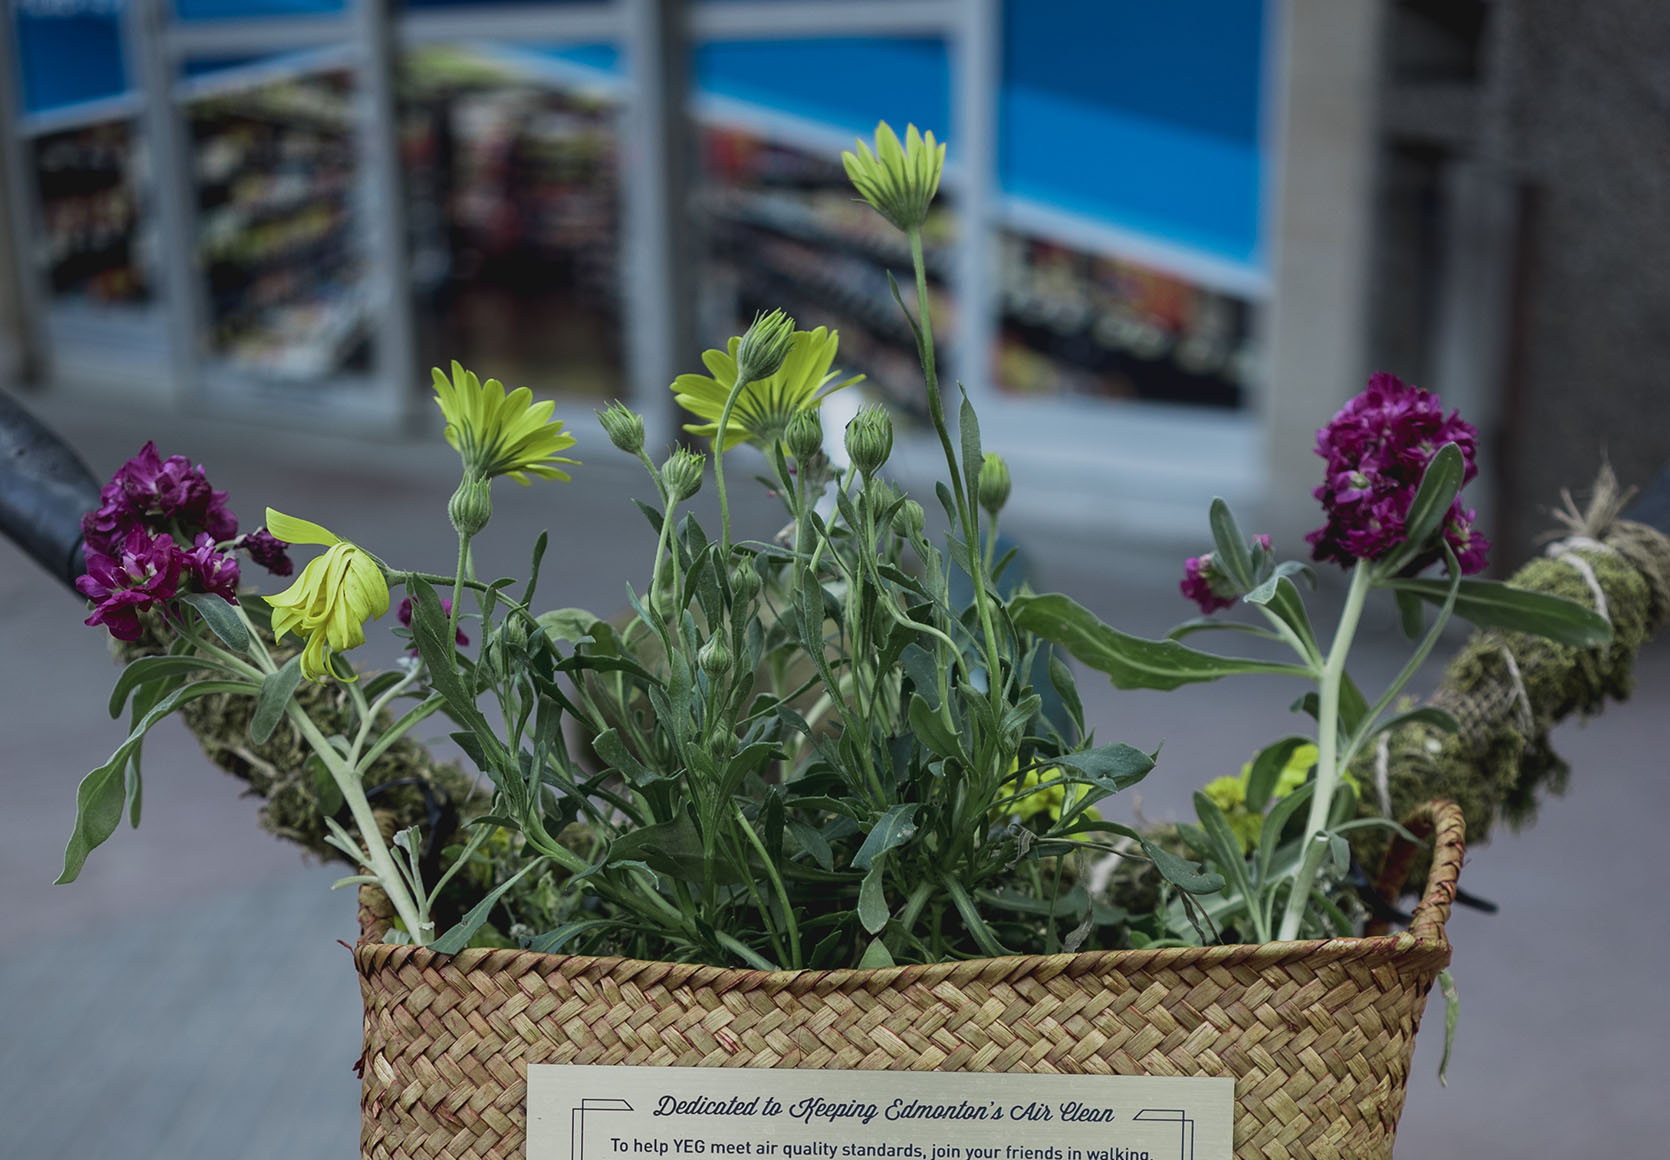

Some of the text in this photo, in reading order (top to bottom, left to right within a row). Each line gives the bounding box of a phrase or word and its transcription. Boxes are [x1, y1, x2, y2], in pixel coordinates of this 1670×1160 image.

[653, 1095, 1115, 1125] Dedicated to Keeping Edmonton's Air Clean
[611, 1138, 629, 1153] To
[633, 1139, 669, 1157] help
[673, 1139, 706, 1154] YEG
[710, 1141, 751, 1155] meet
[755, 1141, 778, 1155] air
[782, 1141, 838, 1160] quality
[842, 1143, 927, 1160] standards,
[1005, 1145, 1063, 1160] friends
[1067, 1146, 1082, 1160] in
